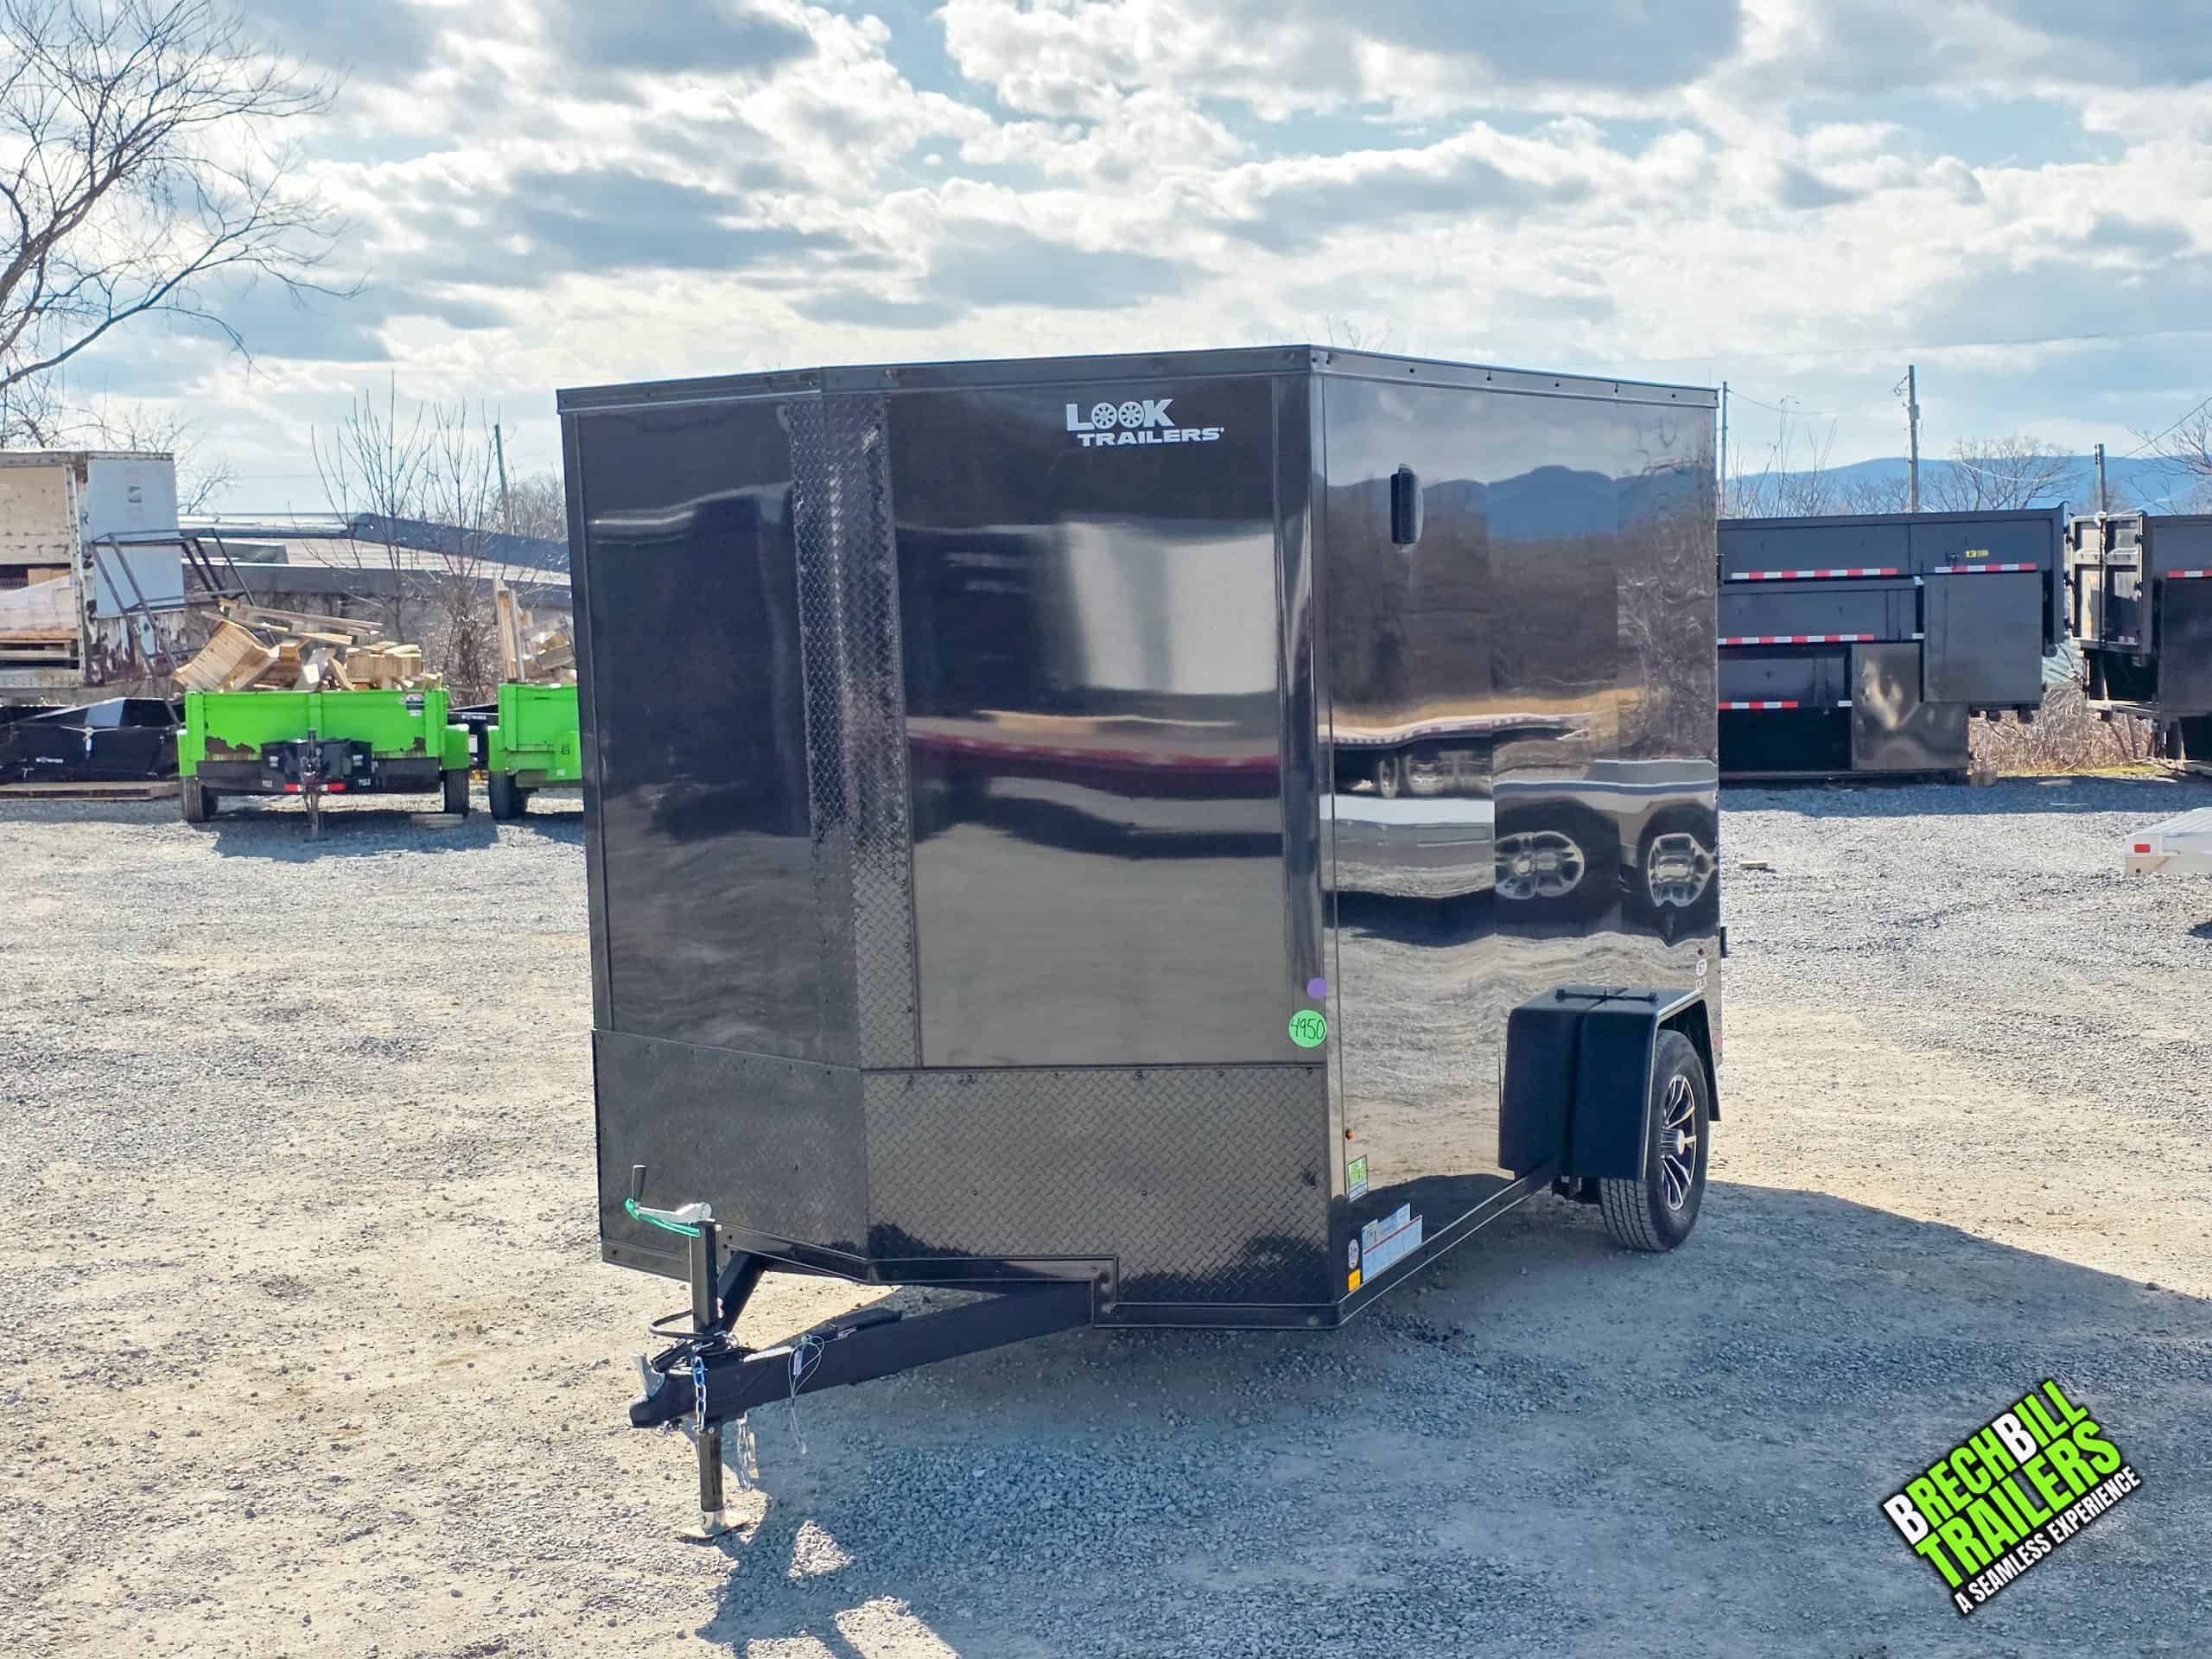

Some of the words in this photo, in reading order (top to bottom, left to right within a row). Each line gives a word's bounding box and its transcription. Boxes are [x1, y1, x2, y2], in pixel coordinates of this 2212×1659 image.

[1065, 398, 1175, 431] LOOK
[1077, 428, 1224, 447] TRAILERS
[1291, 1018, 1325, 1039] 4950
